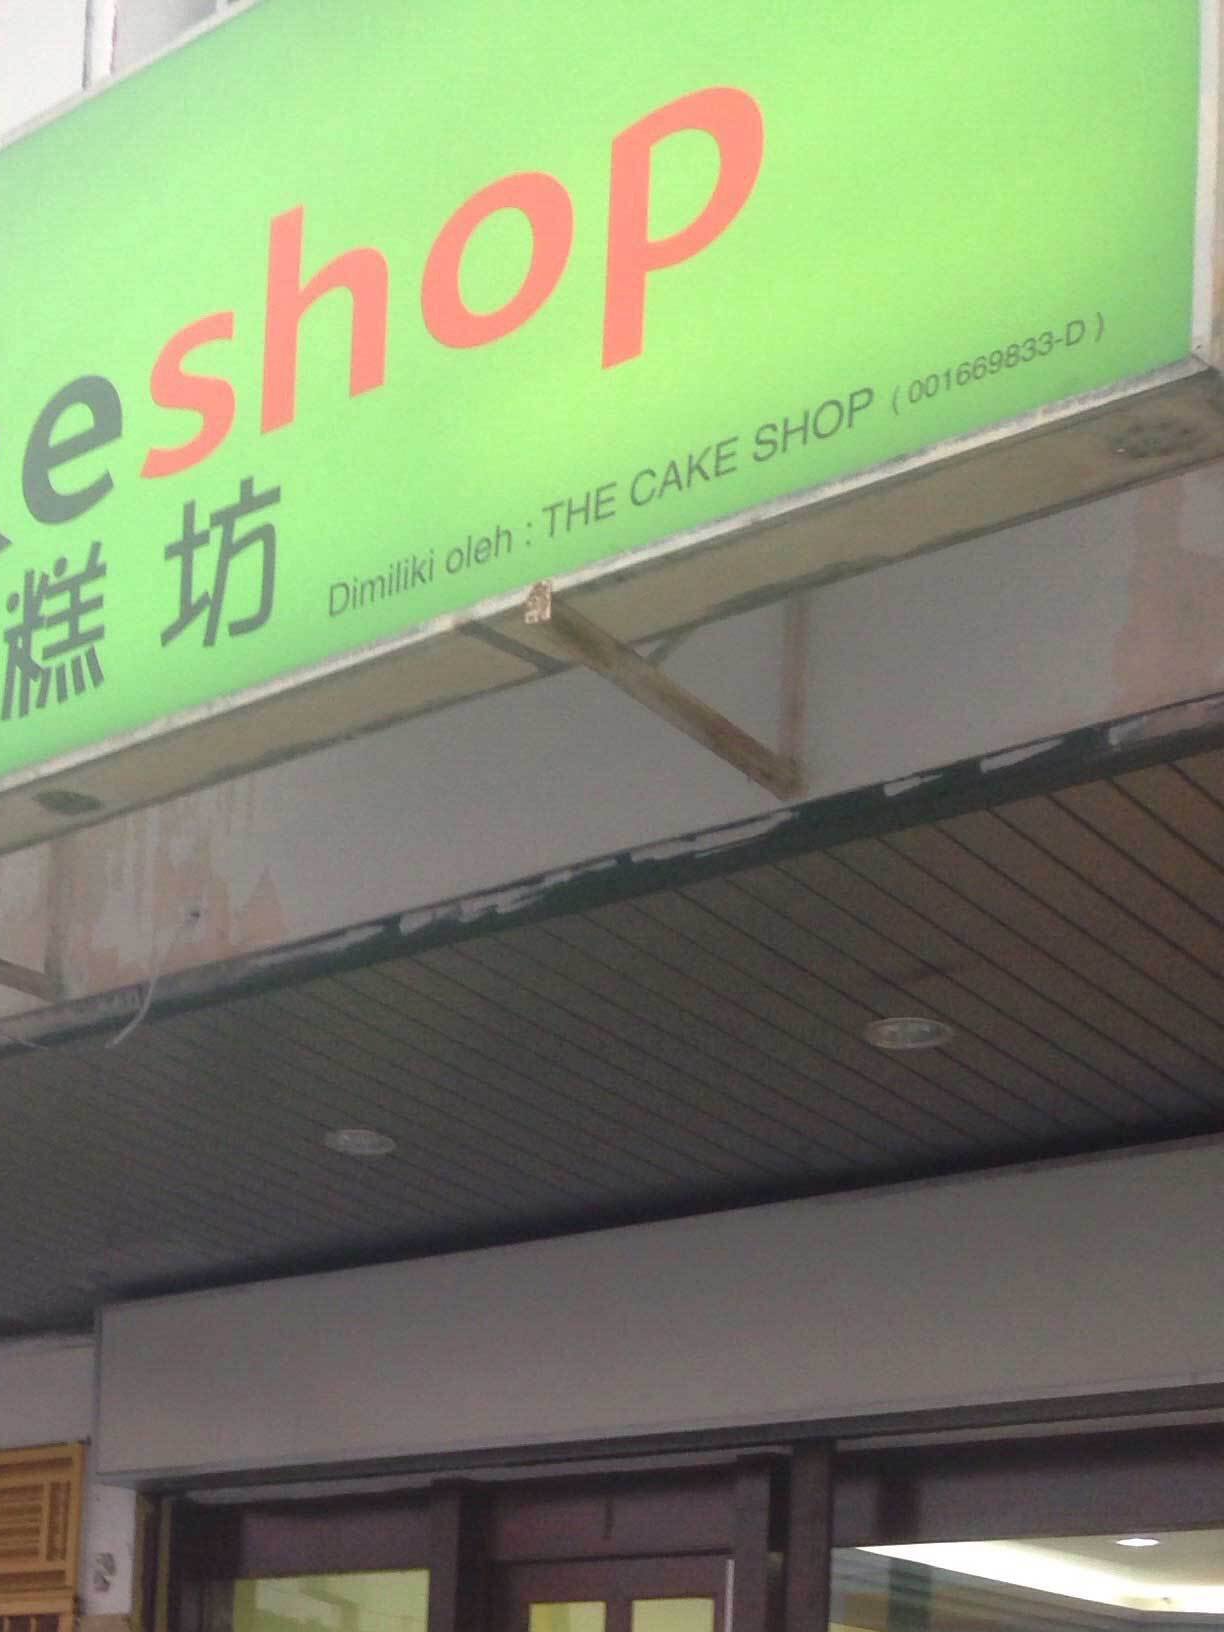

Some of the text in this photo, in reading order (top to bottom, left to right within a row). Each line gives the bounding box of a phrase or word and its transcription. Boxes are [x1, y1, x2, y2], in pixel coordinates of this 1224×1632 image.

[328, 548, 435, 618] Dimiliki
[445, 524, 513, 576] oleh
[542, 481, 618, 539] THE
[630, 436, 738, 508] CAKE
[752, 387, 874, 463] SHOP
